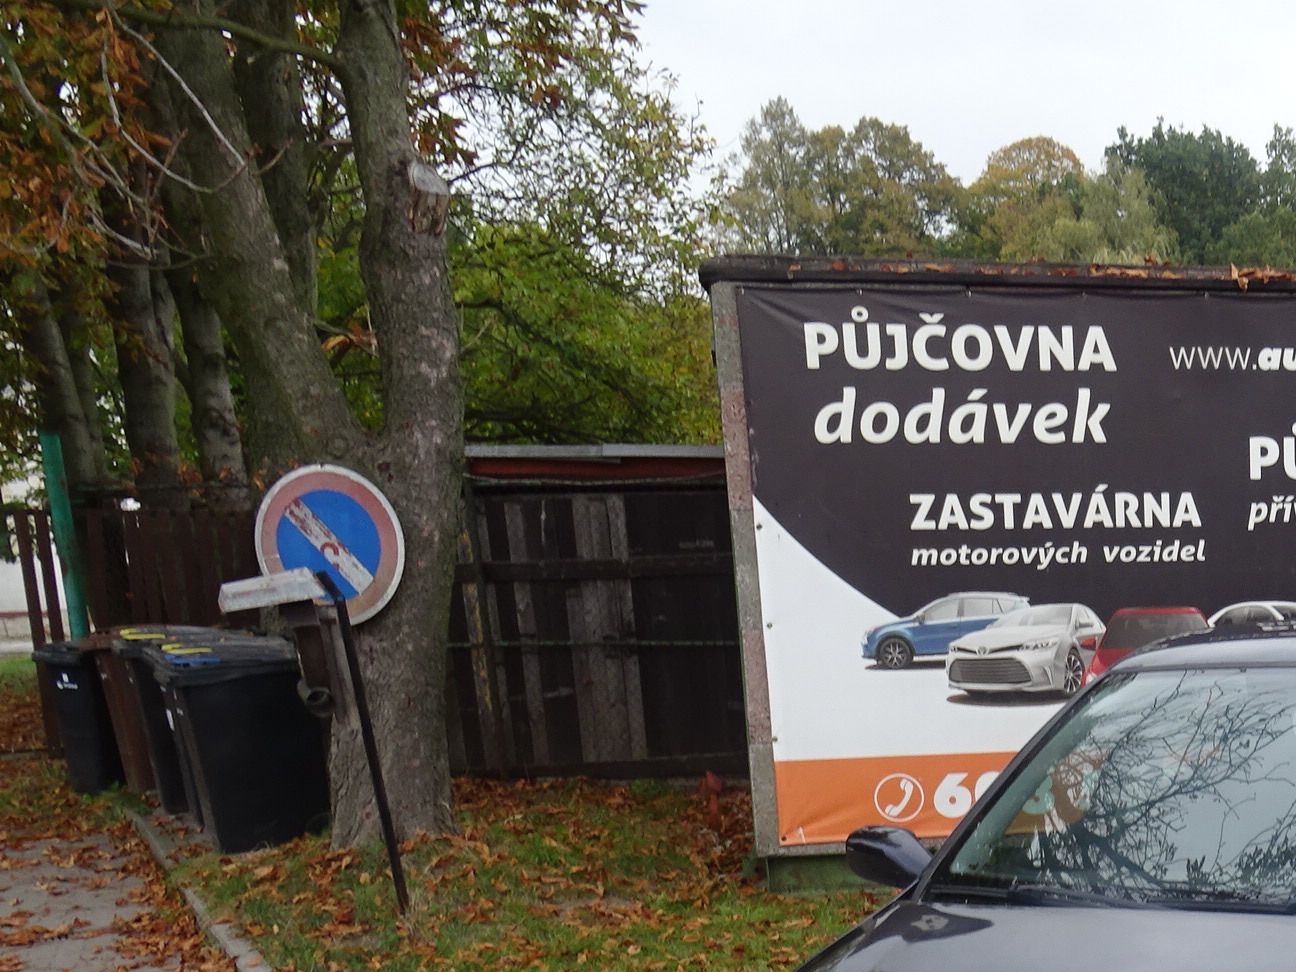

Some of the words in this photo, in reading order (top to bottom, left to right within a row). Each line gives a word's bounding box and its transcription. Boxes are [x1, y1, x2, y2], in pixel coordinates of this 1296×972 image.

[803, 306, 1117, 372] PŮJČOVNA
[813, 386, 1111, 444] dodávek
[909, 484, 1202, 531] ZASTAVÁRNA
[911, 540, 1088, 571] motorových
[1103, 539, 1206, 563] vozidel
